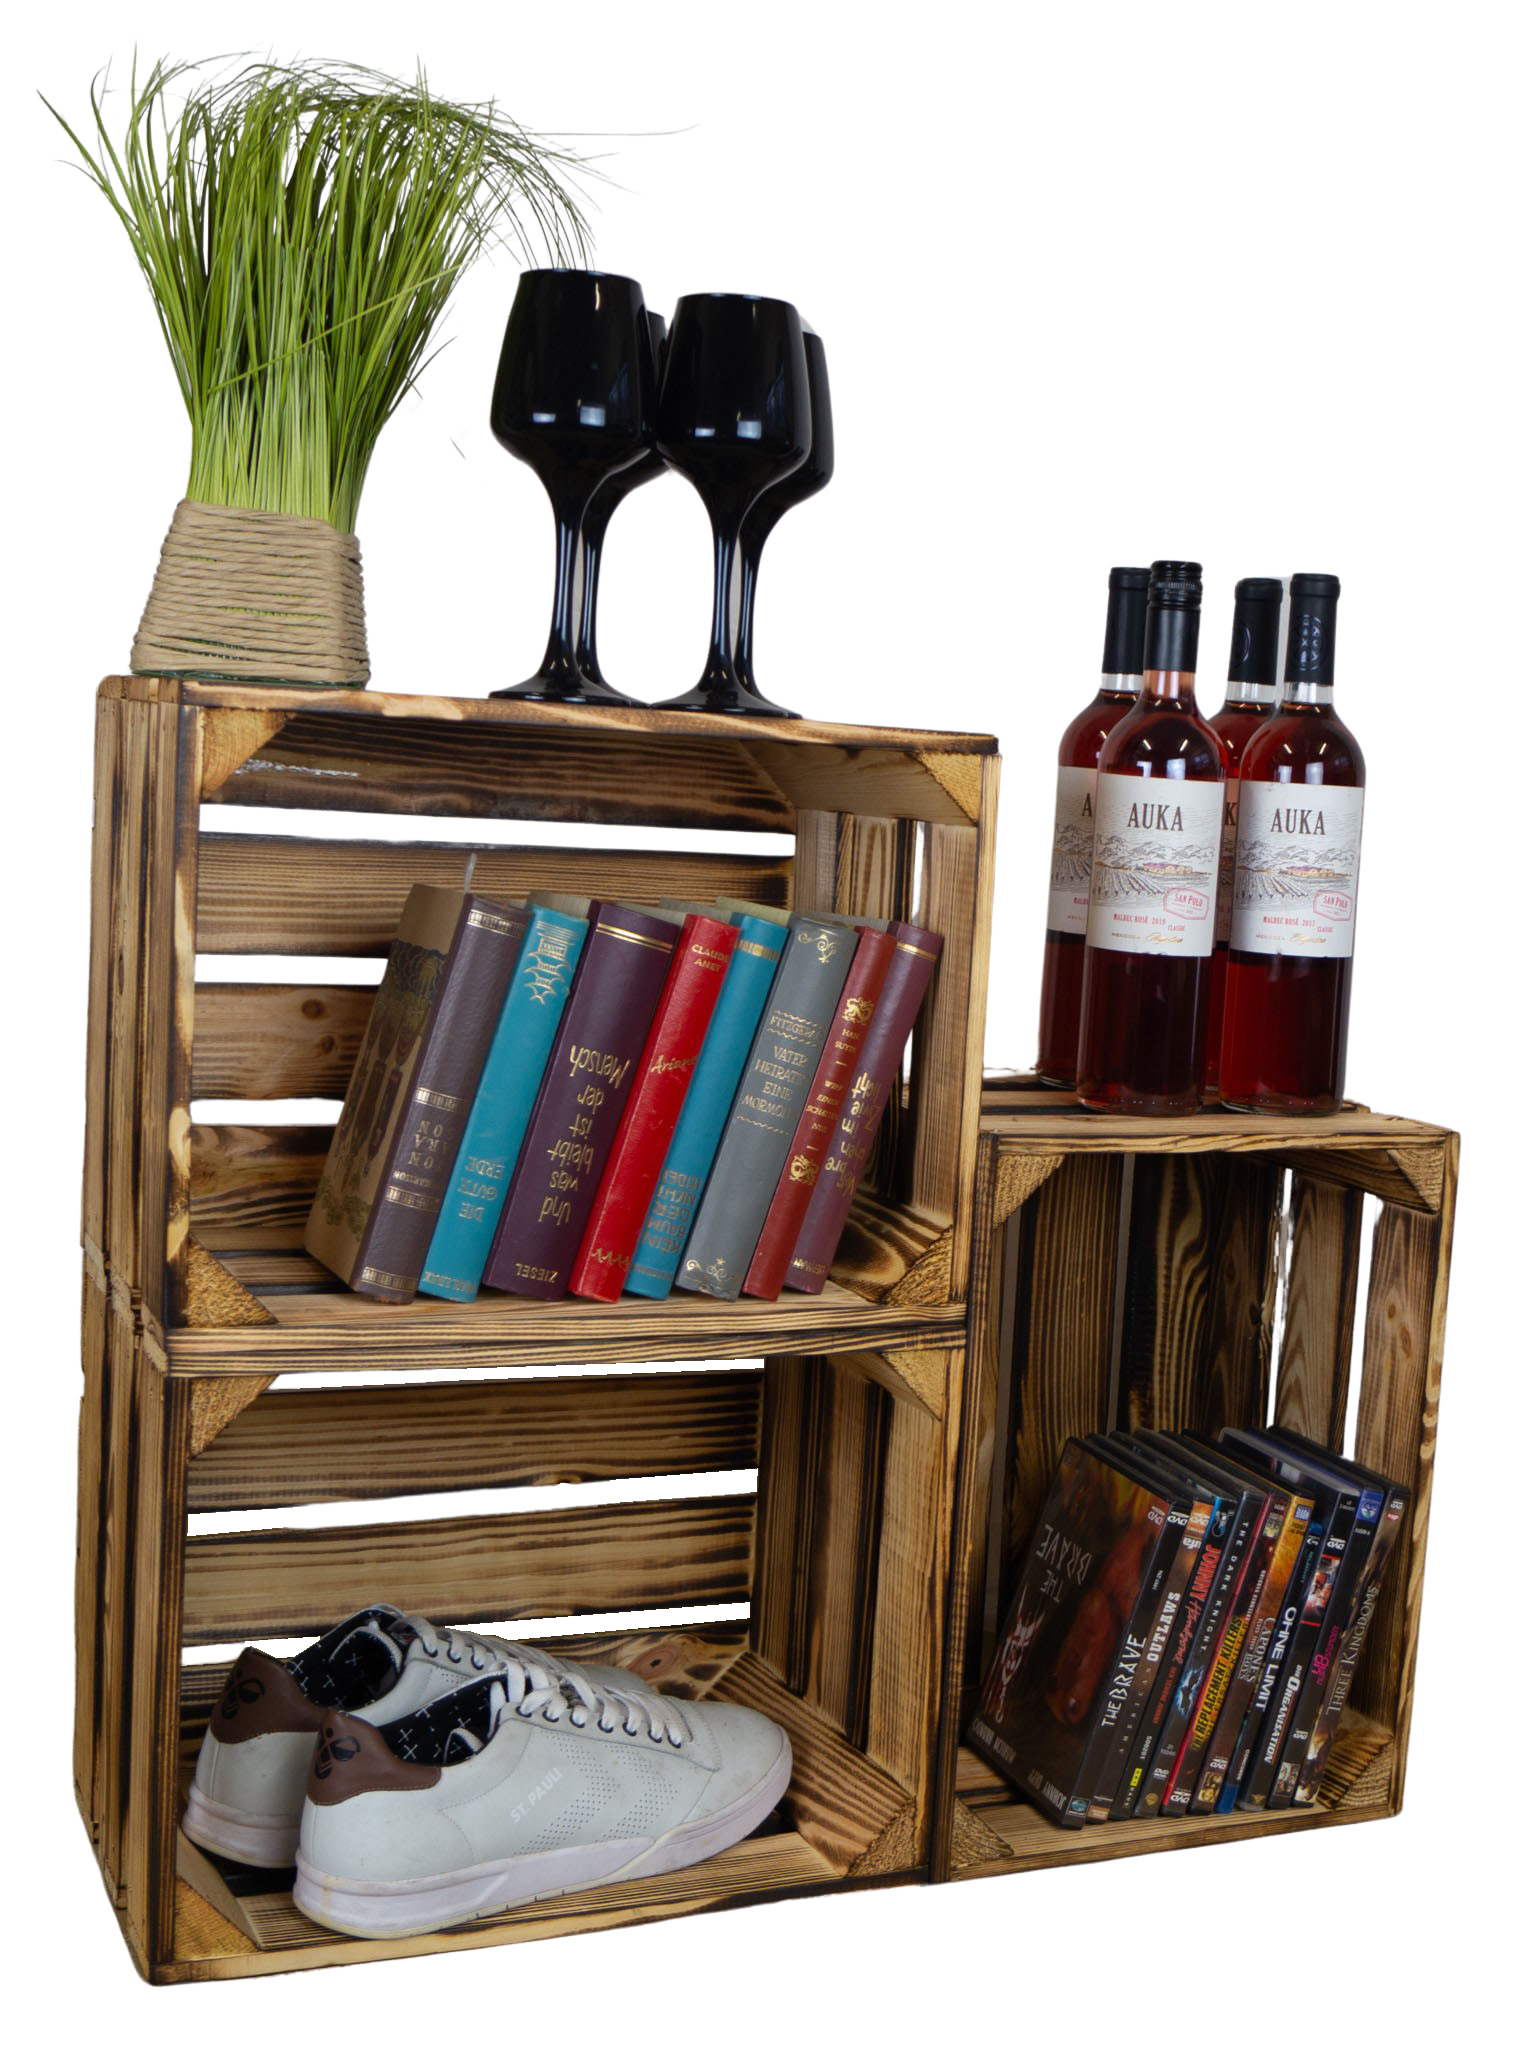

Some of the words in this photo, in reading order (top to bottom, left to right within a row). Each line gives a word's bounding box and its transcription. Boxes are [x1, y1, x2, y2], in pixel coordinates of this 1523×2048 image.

[1127, 802, 1184, 831] AUKA
[1271, 808, 1326, 835] AUKA
[569, 1044, 631, 1089] Mensch
[577, 1084, 605, 1115] der
[762, 1081, 793, 1101] EINE
[568, 1112, 593, 1140] ist
[464, 1156, 506, 1180] ERDE
[547, 1139, 595, 1175] bleibt
[457, 1178, 498, 1201] GUTE
[550, 1171, 579, 1192] was
[458, 1202, 485, 1223] DIE
[538, 1195, 572, 1226] Und
[515, 1262, 558, 1284] ZIESEL
[1147, 1511, 1164, 1526] DVD
[1167, 1515, 1189, 1526] DVD
[1189, 1515, 1209, 1526] DVD
[1182, 1536, 1202, 1549] ufa
[1236, 1521, 1249, 1547] THE
[1327, 1541, 1345, 1550] DVD
[1036, 1523, 1093, 1585] BRAVE
[1040, 1569, 1065, 1604] THE
[1189, 1544, 1222, 1602] JOHNNY
[1220, 1555, 1238, 1591] DARK
[1146, 1591, 1181, 1662] OUTLAWS
[1200, 1600, 1223, 1652] KNIGHT
[1271, 1606, 1297, 1660] OHNE
[1245, 1617, 1276, 1683] CAPONES
[1326, 1668, 1352, 1715] THREE
[1342, 1585, 1379, 1665] KINGDOMS
[1109, 1633, 1147, 1701] BRAVE
[1195, 1659, 1229, 1736] REPLACEMENT
[1221, 1616, 1243, 1662] KILLERS
[1256, 1663, 1280, 1712] LIMIT
[1101, 1700, 1122, 1728] THE
[1264, 1675, 1300, 1763] ORGANISATION
[527, 1767, 562, 1807] PAULI
[1153, 1768, 1169, 1776] DVD
[1170, 1794, 1191, 1804] DVD
